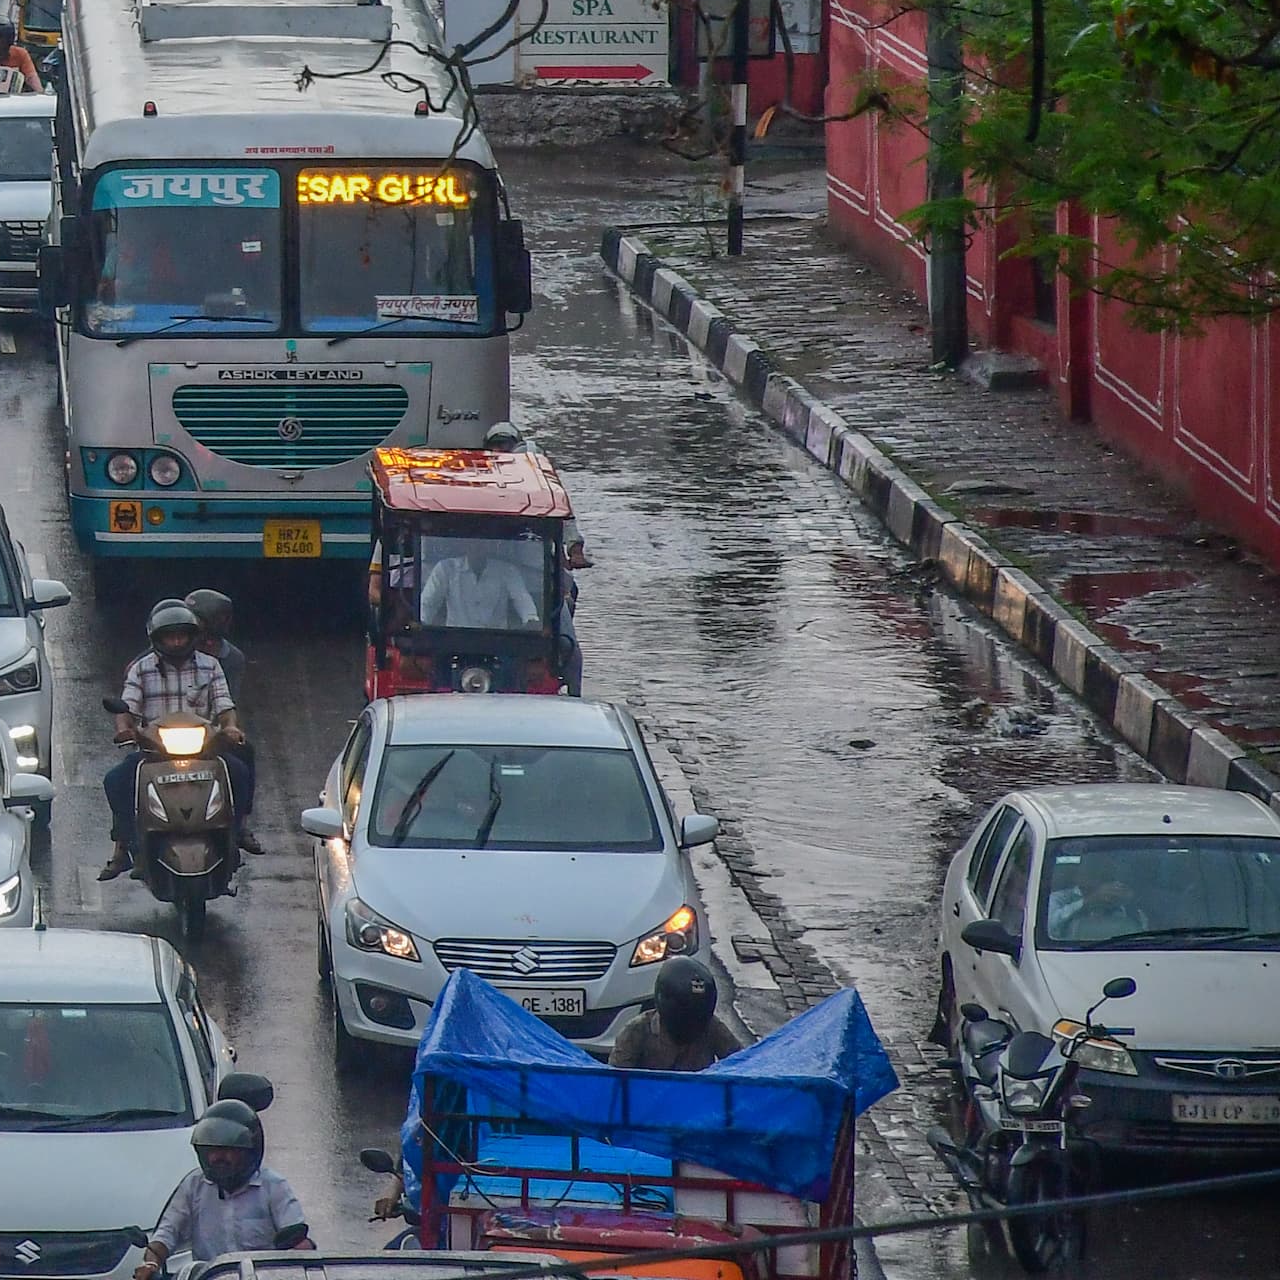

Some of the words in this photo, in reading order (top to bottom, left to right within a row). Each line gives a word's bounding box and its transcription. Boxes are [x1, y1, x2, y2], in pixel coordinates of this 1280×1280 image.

[572, 0, 614, 16] SPA
[530, 30, 659, 45] RESTAURANT
[121, 174, 270, 206] जयपुर
[220, 371, 276, 380] ASHOK
[286, 371, 363, 380] LEYLAND
